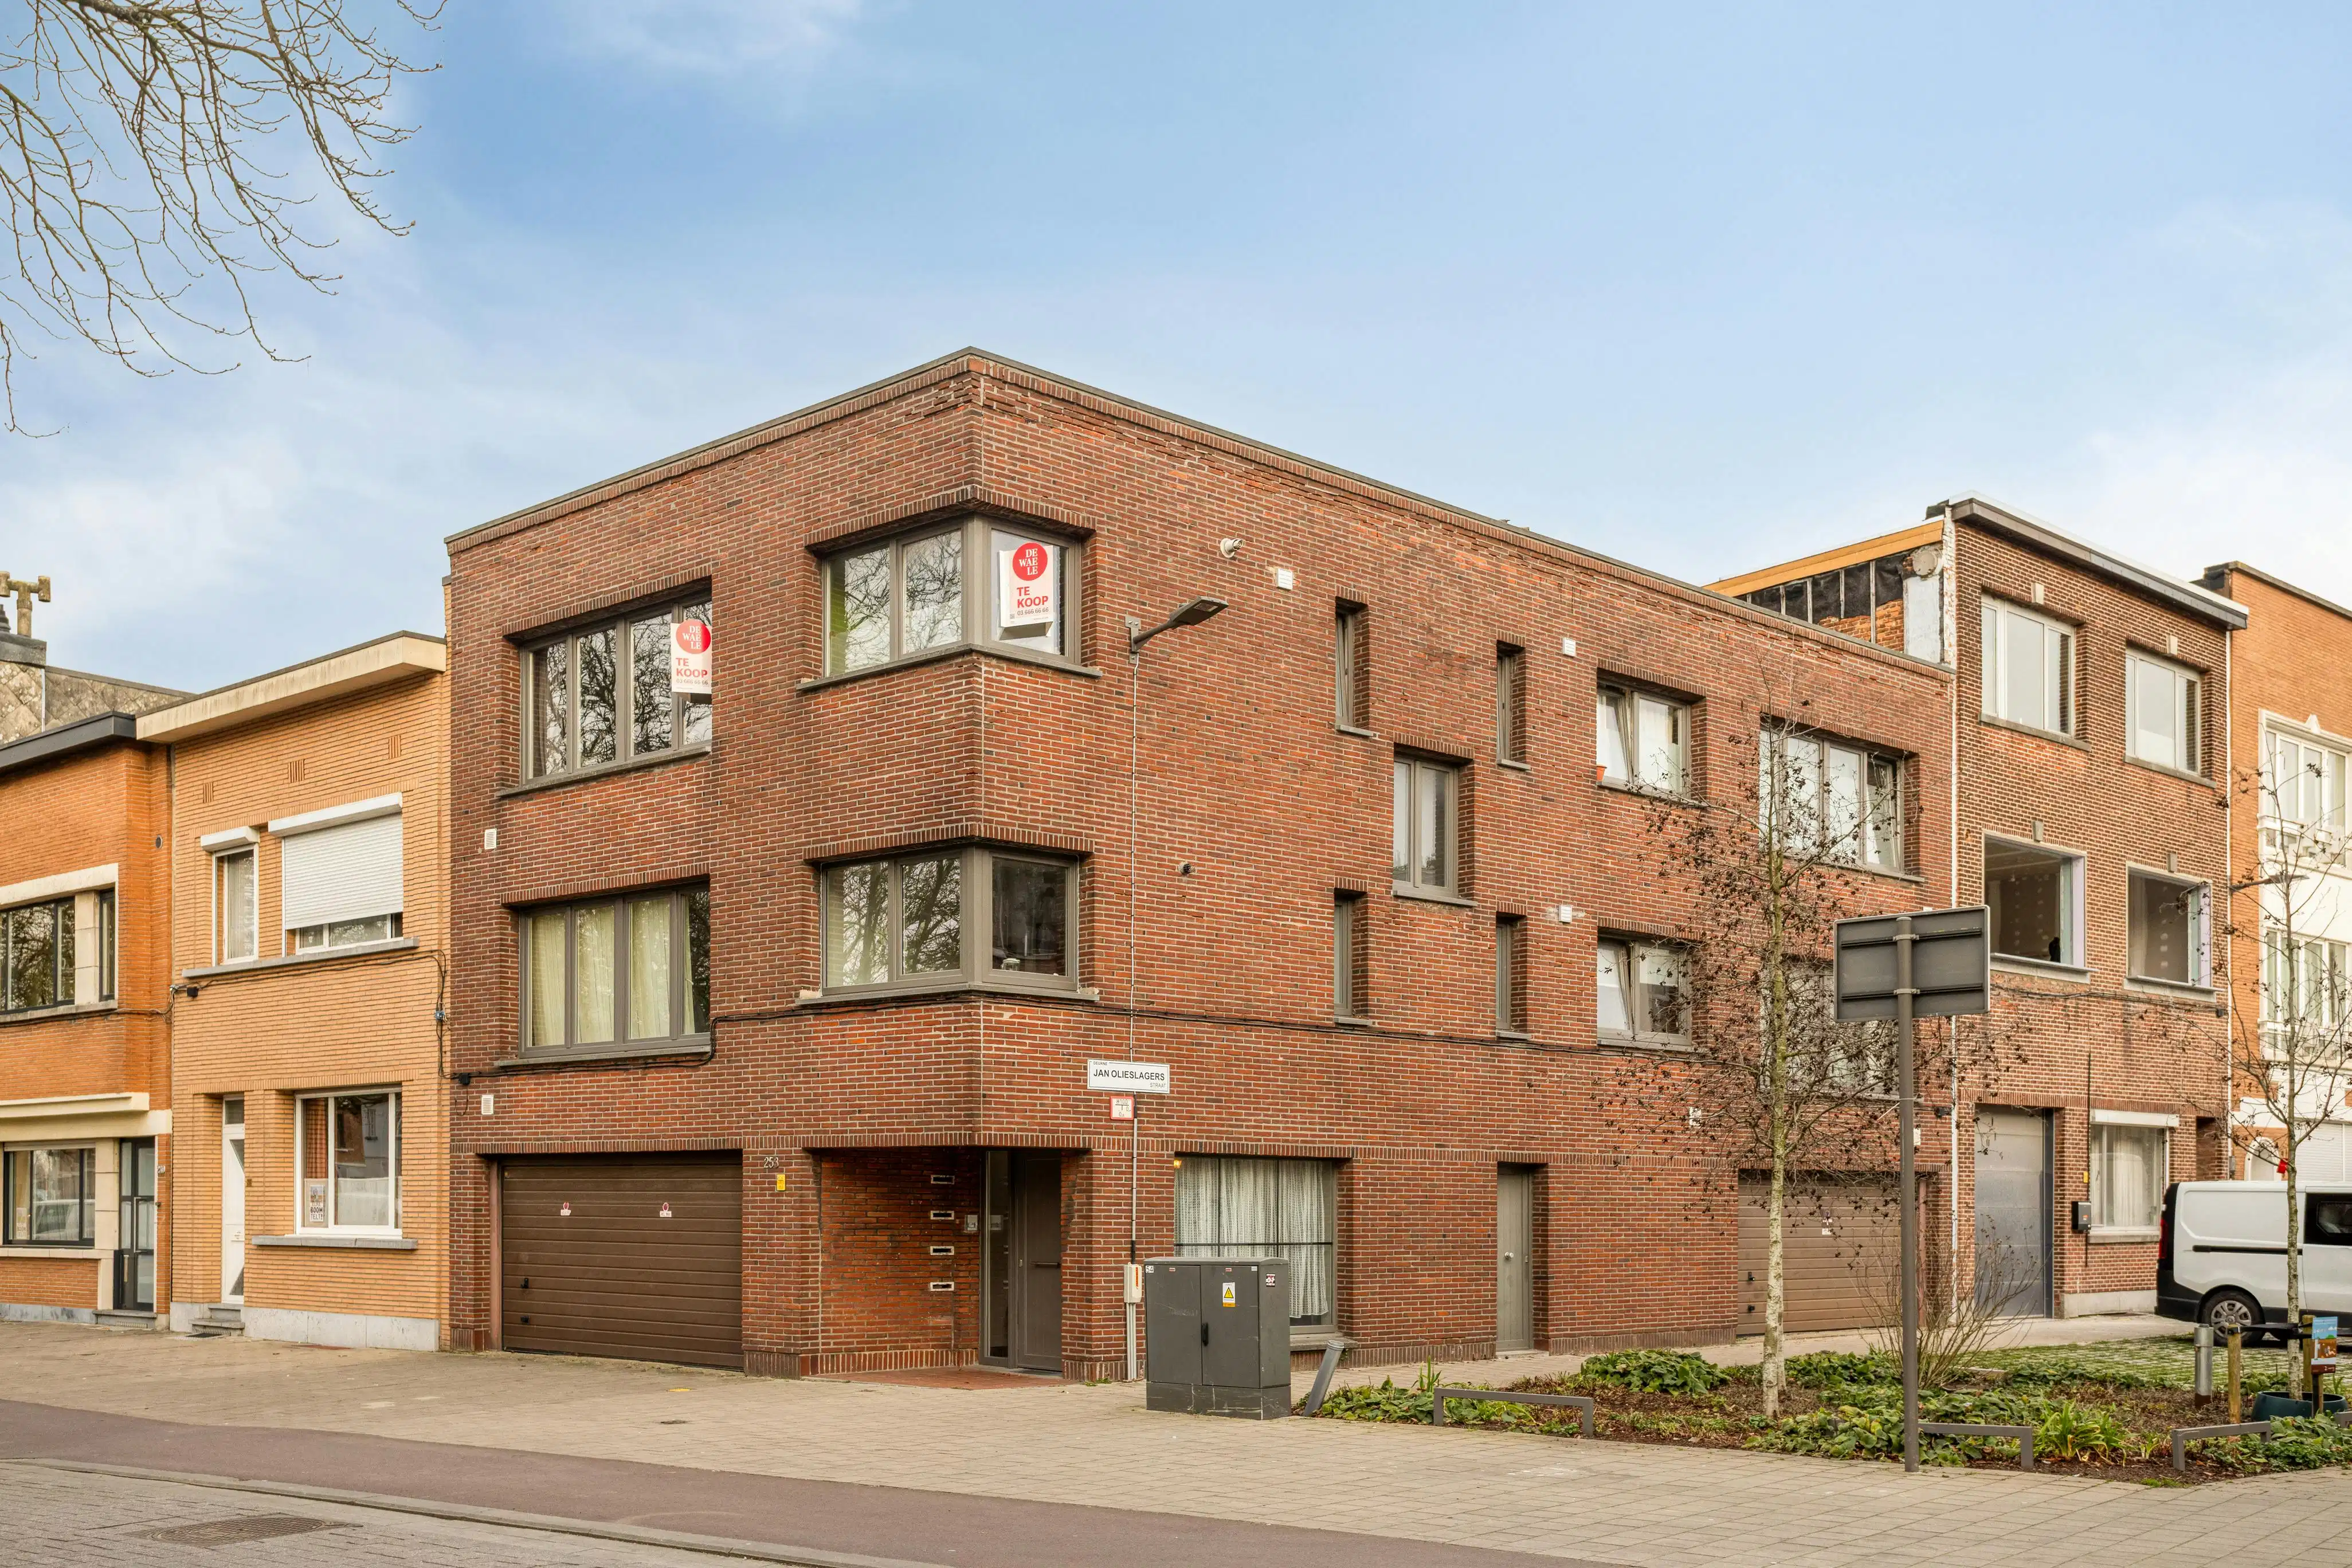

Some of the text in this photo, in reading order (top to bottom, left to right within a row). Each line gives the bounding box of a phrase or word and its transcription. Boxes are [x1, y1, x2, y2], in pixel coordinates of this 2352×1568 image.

[1026, 548, 1038, 558] DE
[1018, 557, 1038, 567] WAE
[1027, 566, 1038, 575] LE
[1017, 586, 1030, 597] TE
[1017, 595, 1048, 608] KOOP
[689, 625, 701, 634] DE
[682, 633, 701, 642] WAE
[691, 641, 701, 649] LE
[676, 658, 689, 667] TE
[676, 668, 708, 678] KOOP
[1093, 1069, 1165, 1081] JAN OLIESLAGERS
